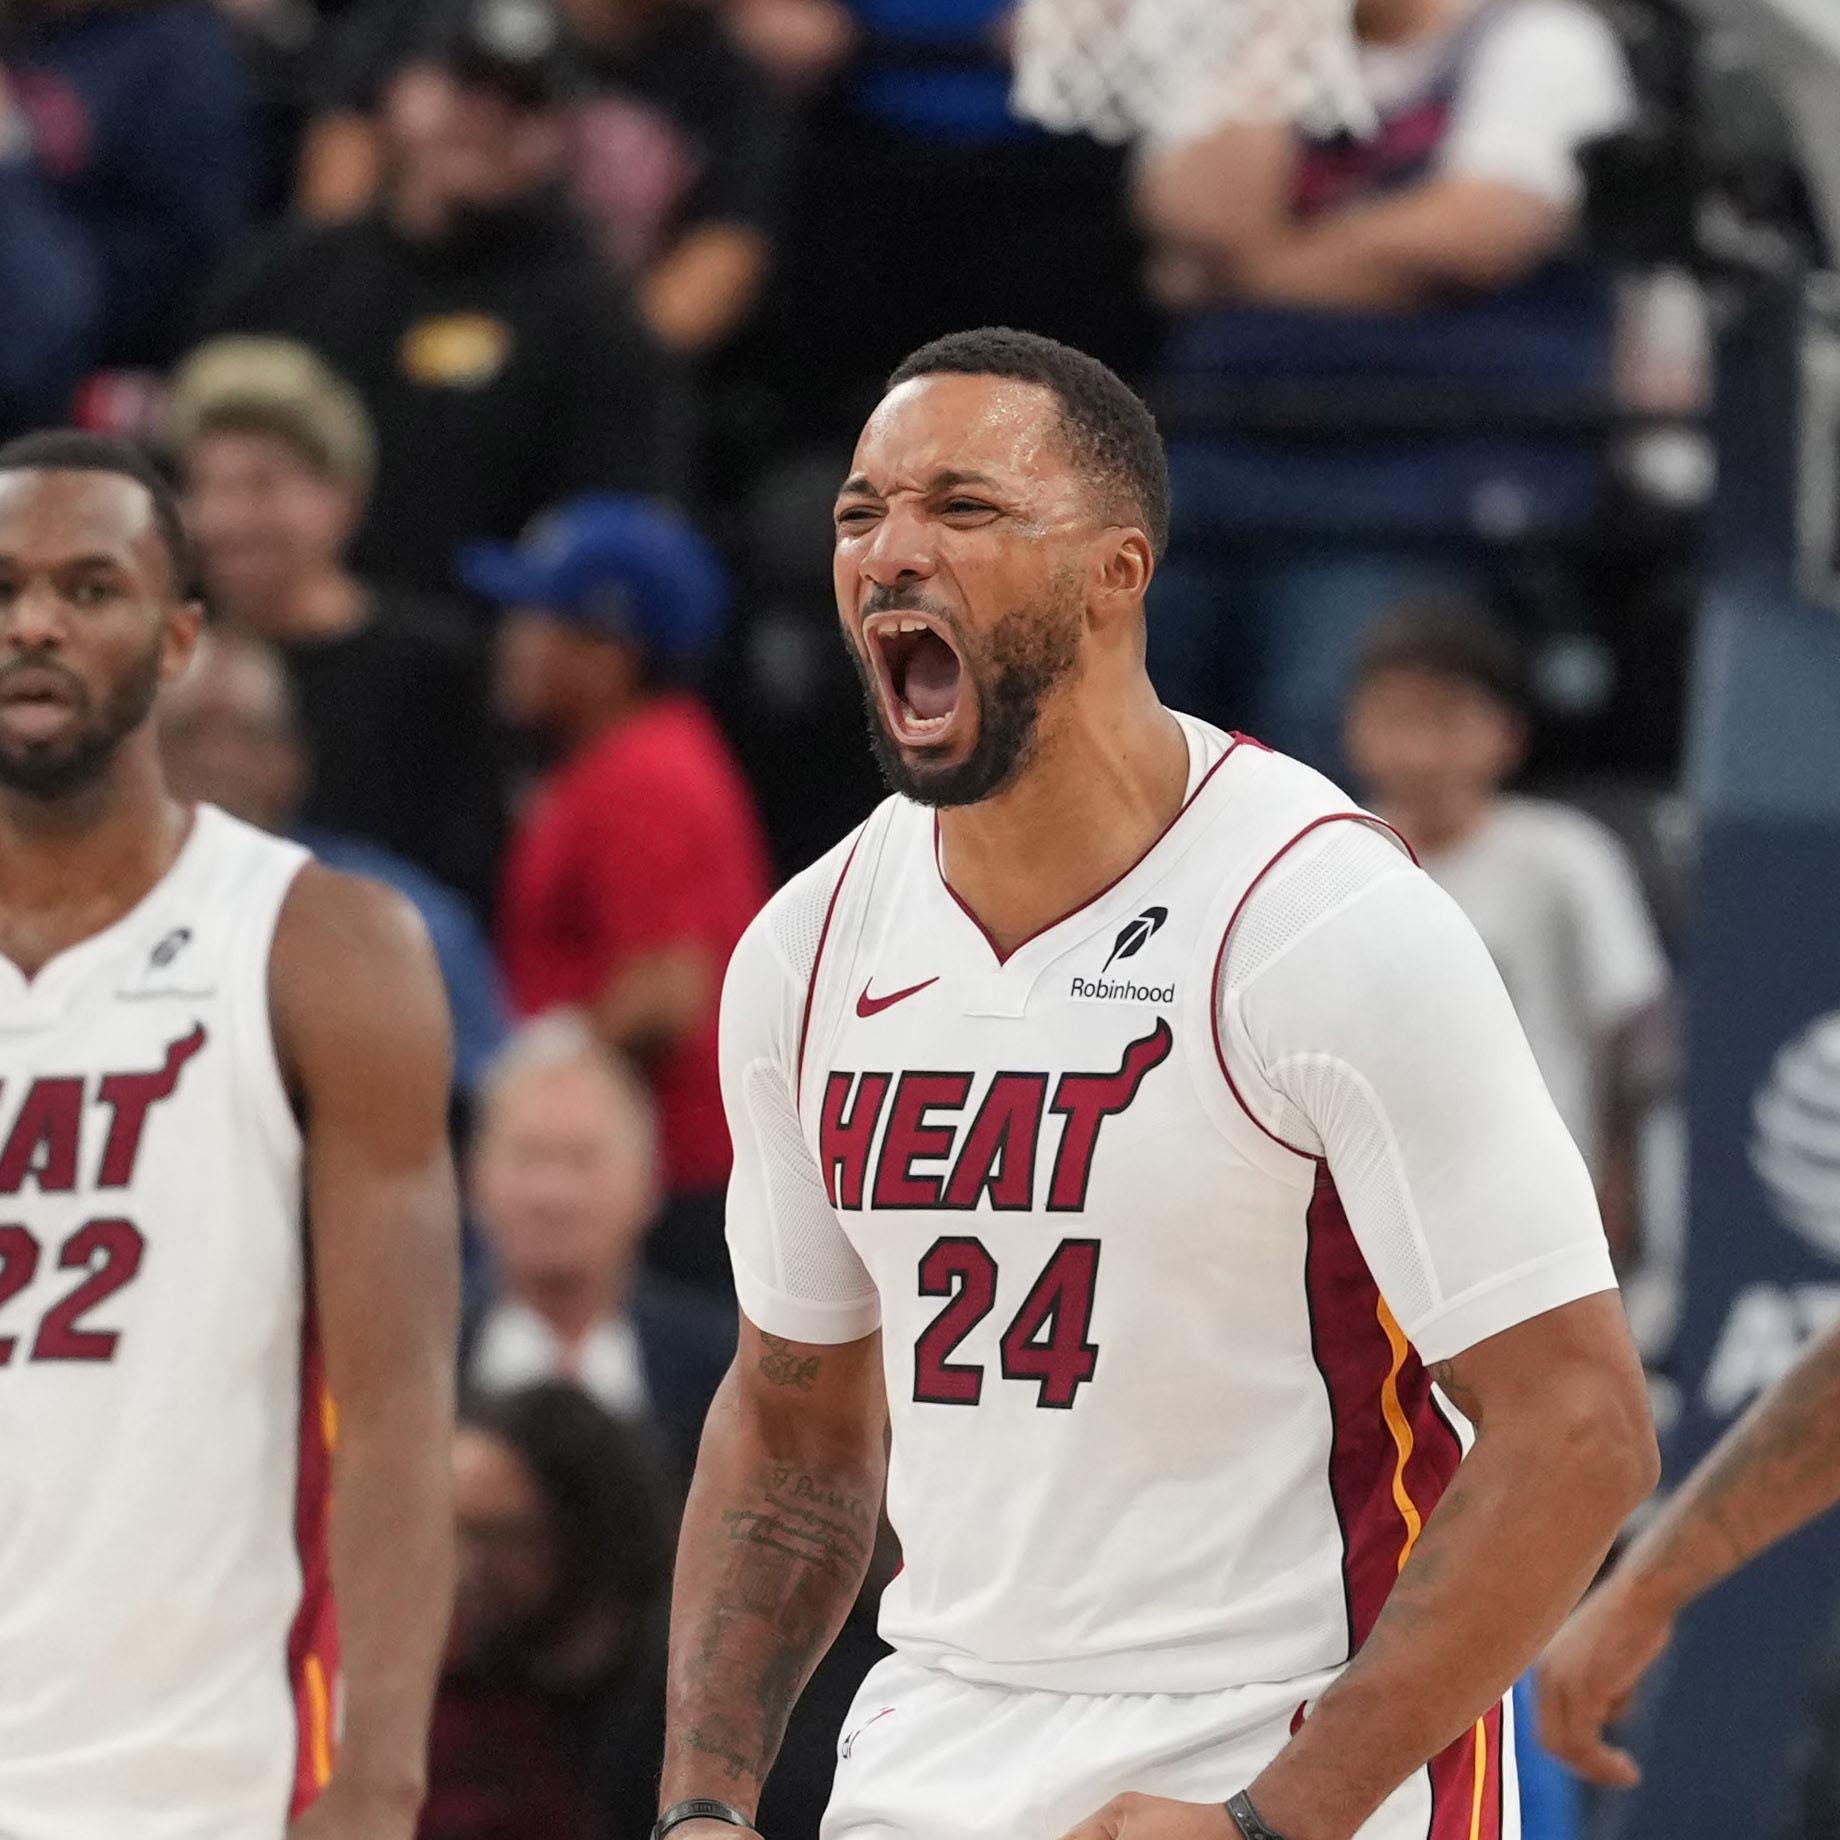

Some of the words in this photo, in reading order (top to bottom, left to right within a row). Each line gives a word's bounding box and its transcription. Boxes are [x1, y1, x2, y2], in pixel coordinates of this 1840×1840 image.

[1071, 977, 1175, 1004] Robinhood
[819, 1016, 1174, 1212] HEAT
[913, 1236, 1101, 1409] 24
